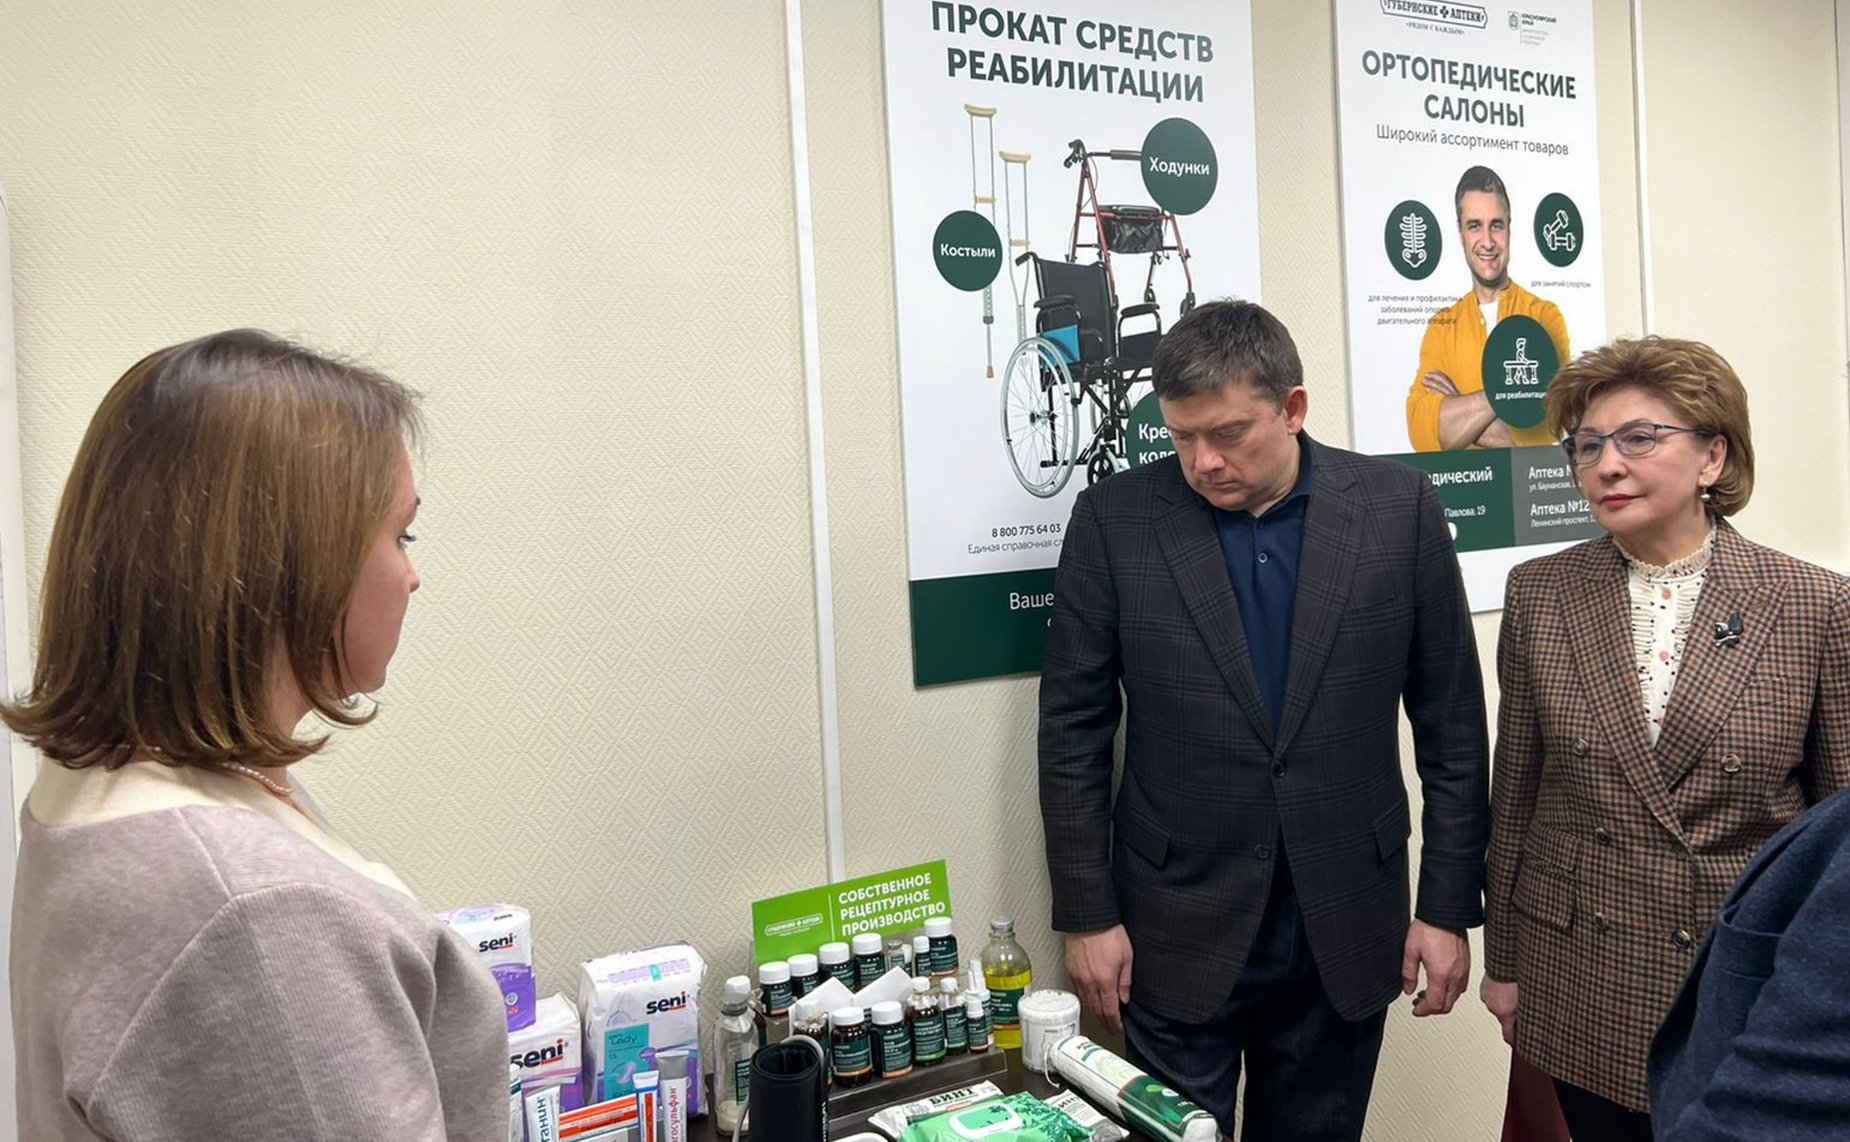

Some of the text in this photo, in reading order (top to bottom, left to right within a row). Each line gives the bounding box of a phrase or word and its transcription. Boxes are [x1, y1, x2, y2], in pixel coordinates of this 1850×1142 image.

[932, 1, 1214, 62] ПРОКАТ СРЕДСТВ
[948, 47, 1204, 103] РЕАБИЛИТАЦИИ
[1362, 50, 1577, 99] ОРТОПЕДИЧЕСКИЕ
[1424, 94, 1524, 127] САЛОНЫ
[1377, 124, 1568, 157] Широкий ассортимент товаров
[1149, 156, 1210, 177] Ходунки
[940, 243, 996, 258] Костыли
[1507, 390, 1546, 400] реабилитаци
[1428, 466, 1493, 487] дический
[1528, 466, 1564, 479] Аптека
[1444, 505, 1486, 518] Павлова, 19
[1530, 503, 1566, 516] Аптека
[992, 523, 1061, 538] 8 800 775 64 03
[968, 544, 1000, 554] Единая
[1001, 540, 1051, 552] справочная
[1010, 591, 1054, 610] Ваше
[838, 873, 932, 904] СОБСТВЕННОЕ
[840, 889, 930, 920] РЕЦЕПТУРНОЕ
[842, 901, 945, 936] ПРОИЗВОДСТВО
[479, 933, 513, 952] seni
[646, 991, 686, 1015] seni
[511, 1038, 563, 1069] seni
[928, 1087, 975, 1104] БИНТ
